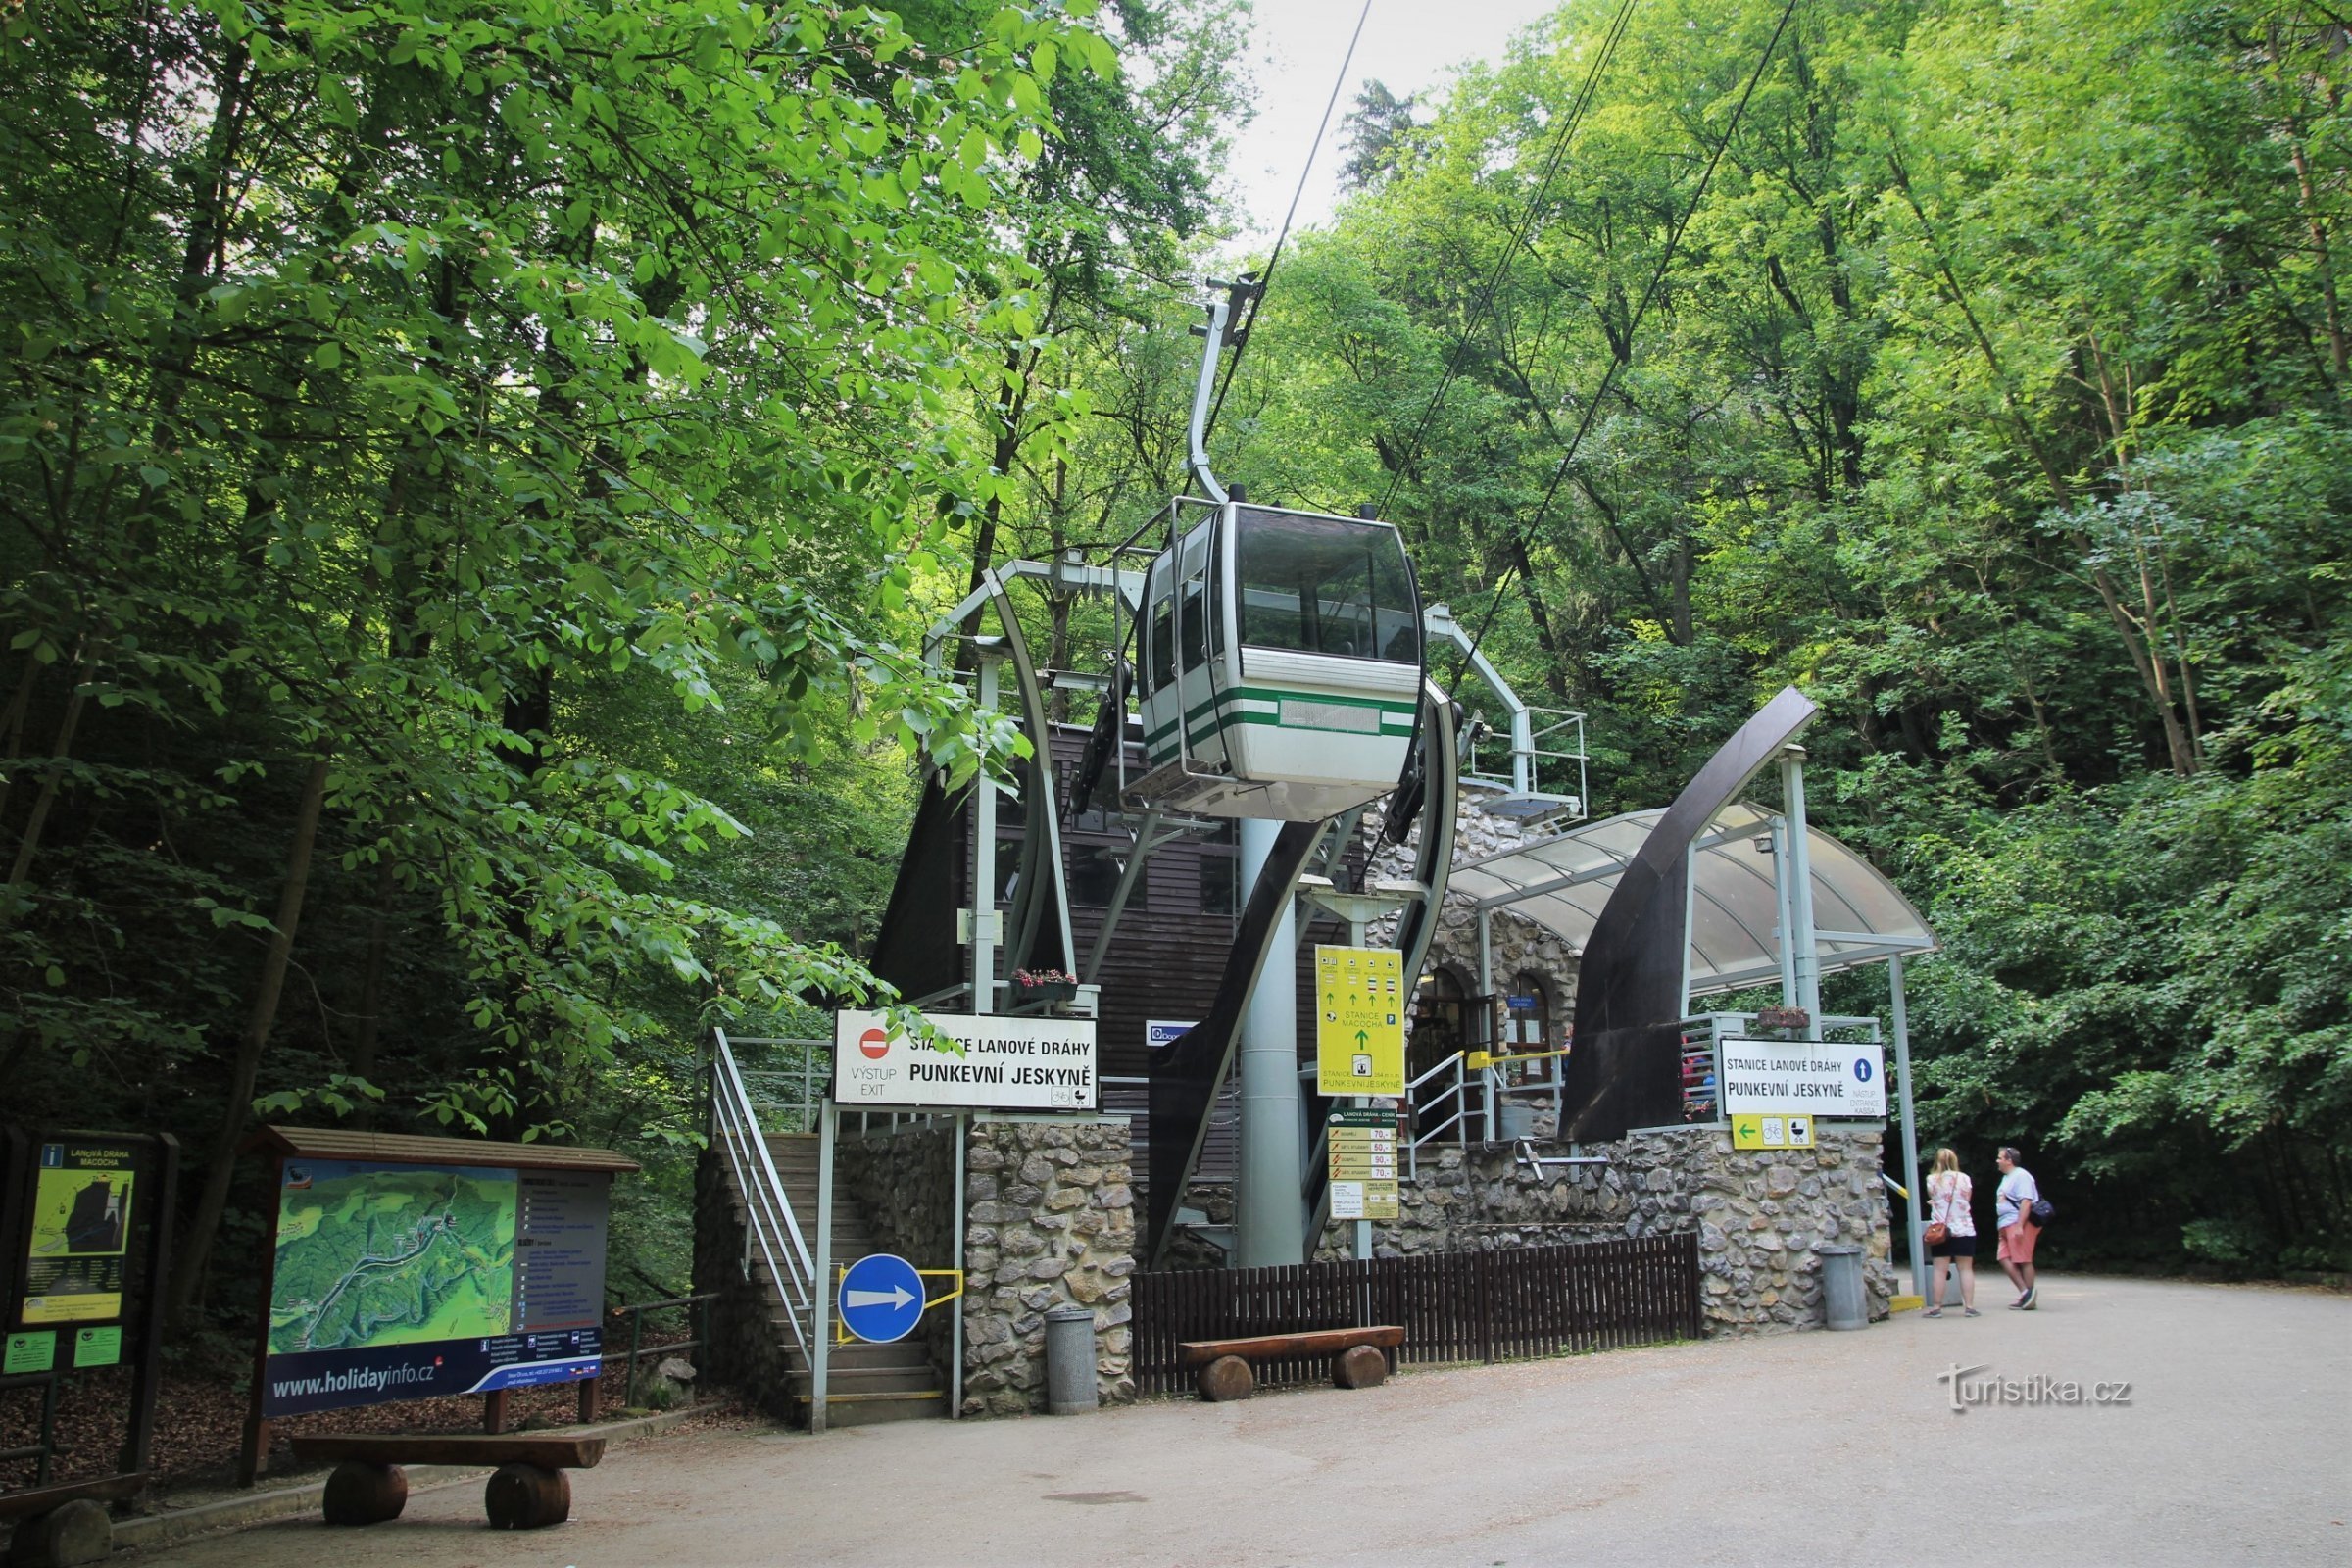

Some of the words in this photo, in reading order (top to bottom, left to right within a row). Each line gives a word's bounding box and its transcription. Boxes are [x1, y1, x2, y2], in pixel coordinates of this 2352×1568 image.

[1345, 1011, 1380, 1020] STANICE
[1343, 1020, 1383, 1029] MACOCHA
[910, 1036, 972, 1053] STACE
[978, 1037, 1035, 1054] LANOVÉ
[1042, 1038, 1090, 1055] DRÁHY
[1727, 1058, 1767, 1071] STANICE
[1770, 1057, 1807, 1072] LANOVÉ
[1811, 1058, 1841, 1072] DRÁHY
[851, 1065, 897, 1080] VÝSTUP
[909, 1061, 1005, 1084] PUNKEVNÍ
[1011, 1065, 1091, 1086] JESKYNĚ
[861, 1084, 885, 1096] EXIT
[1729, 1079, 1788, 1097] PUNKEVNÍ
[1793, 1081, 1844, 1098] JESKYNĚ
[1849, 1099, 1881, 1107] ENTRANCE
[80, 1157, 119, 1166] MACOCHA
[273, 1362, 434, 1398] www.holidayinfo.cz
